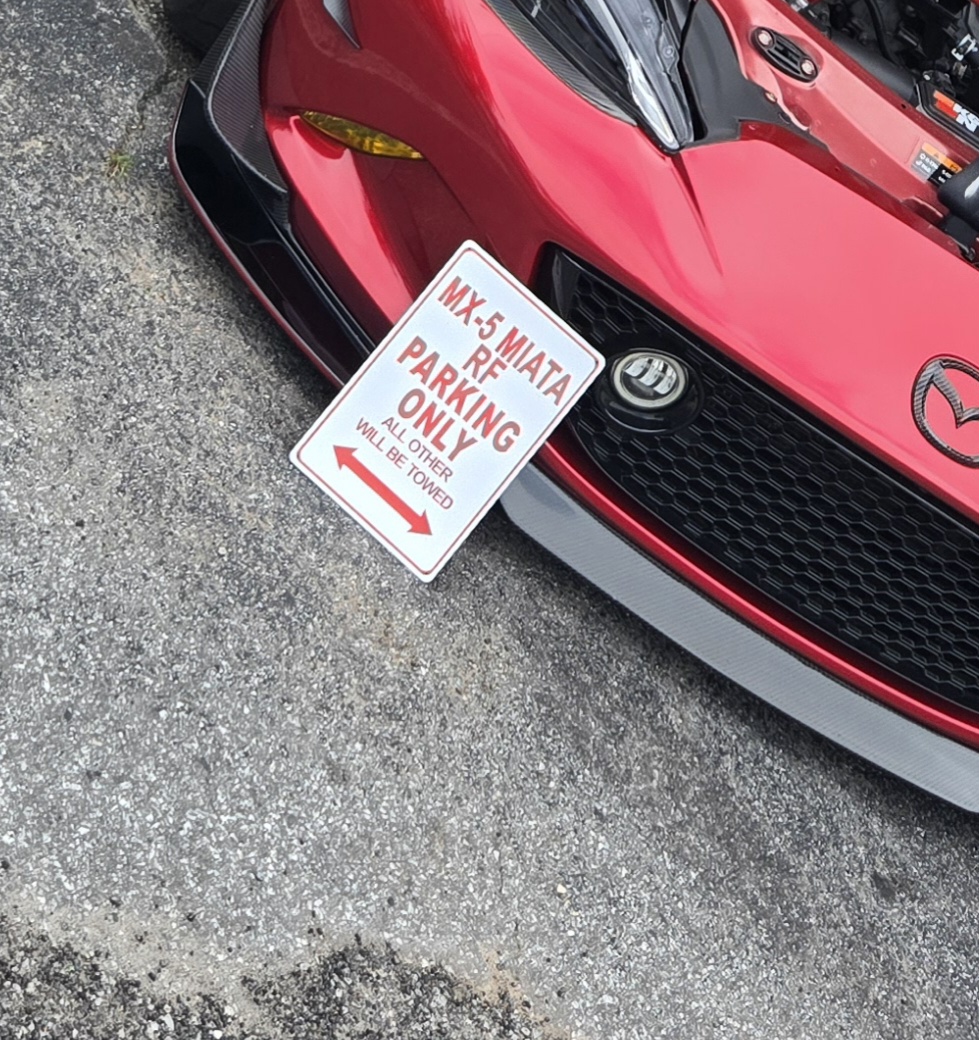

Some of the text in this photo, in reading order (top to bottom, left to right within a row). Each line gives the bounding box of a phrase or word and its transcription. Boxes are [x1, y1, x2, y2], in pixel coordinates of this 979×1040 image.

[437, 276, 572, 406] MX-5 MIATA
[462, 344, 507, 385] RF
[397, 336, 520, 453] PARKING
[397, 389, 477, 462] ONLY
[356, 417, 453, 510] WILL BE TOWED
[381, 417, 453, 483] ALL OTHER
